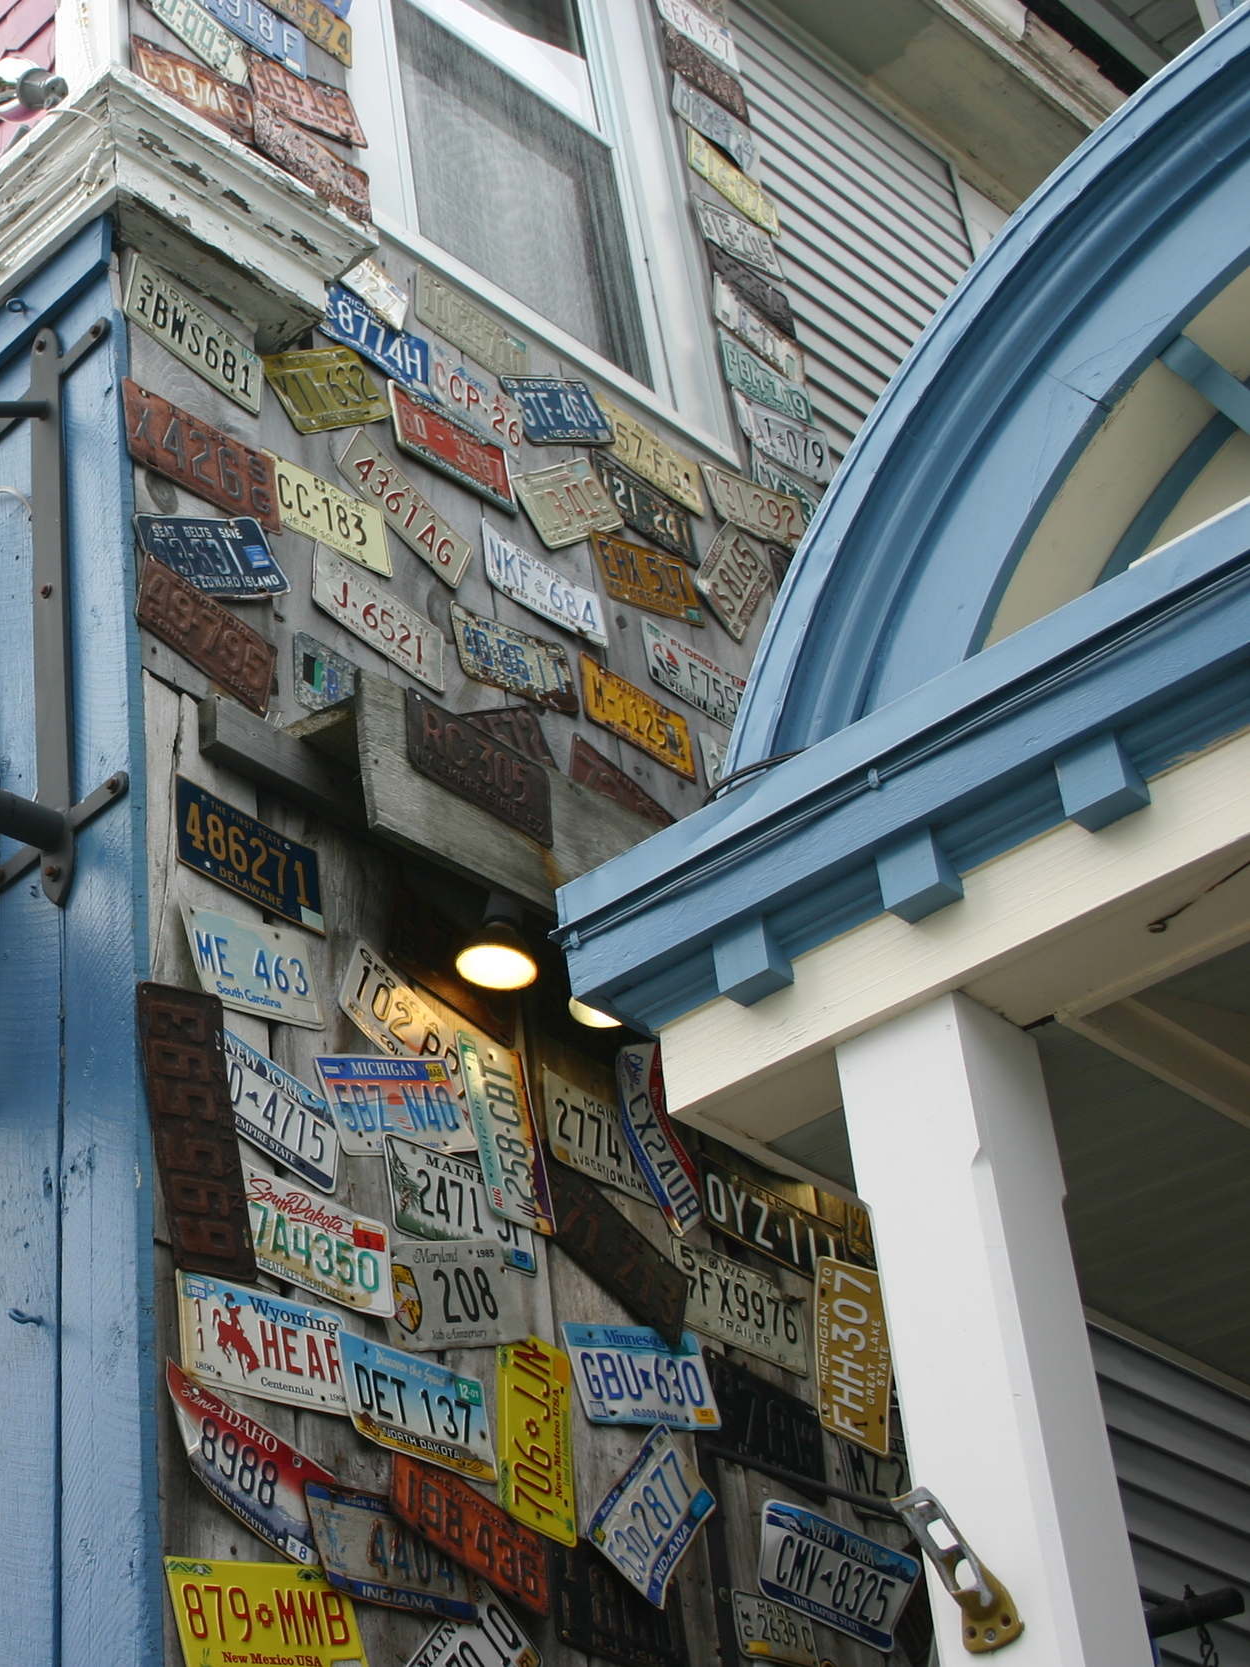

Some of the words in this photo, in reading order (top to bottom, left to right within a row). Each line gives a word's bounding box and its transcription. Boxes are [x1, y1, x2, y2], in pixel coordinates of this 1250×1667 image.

[150, 291, 252, 396] BWS681
[547, 428, 591, 441] NELSON
[277, 472, 369, 547] CC-183
[385, 464, 438, 527] ALASKA
[151, 525, 177, 539] SEAT
[183, 525, 213, 539] BELTS
[217, 526, 244, 540] SAVE
[317, 526, 365, 561] souviens
[200, 574, 241, 590] EDWARD
[241, 573, 280, 589] ISLAND
[550, 581, 598, 630] 684
[669, 638, 722, 676] FLORIDA
[230, 809, 255, 830] FIRST
[257, 823, 283, 849] STATE
[186, 801, 311, 907] 486271
[219, 865, 284, 910] DELAWARE
[216, 981, 247, 1005] South
[245, 988, 283, 1010] Carolina
[252, 949, 310, 998] 463
[359, 947, 441, 1036] GEORGIA
[356, 965, 413, 1046] 102
[223, 1034, 260, 1076] NEW
[258, 1062, 303, 1104] YORK
[350, 1061, 418, 1077] MICHIGAN
[234, 1116, 269, 1147] EMPIRE
[269, 1137, 297, 1164] STATE
[260, 1096, 326, 1163] 4715
[467, 1077, 496, 1169] ARIZONA
[425, 1152, 485, 1186] MAINE
[285, 1191, 348, 1235] Dakota
[491, 1187, 505, 1210] AUG
[247, 1201, 380, 1293] 7A4350
[412, 1248, 459, 1270] Maryland
[475, 1248, 496, 1259] 1985
[248, 1295, 340, 1340] Wyoming
[432, 1266, 499, 1324] 208
[699, 1265, 798, 1345] FX9976
[602, 1329, 667, 1350] Minnesota
[717, 1315, 771, 1347] TRAILER
[819, 1302, 830, 1385] MICHIGAN
[195, 1361, 216, 1374] 1890
[260, 1376, 315, 1397] Centennial
[374, 1350, 409, 1376] Discover
[579, 1351, 644, 1400] GBU
[652, 1355, 706, 1407] 630
[352, 1362, 407, 1424] DET
[418, 1389, 473, 1444] 137
[657, 1409, 679, 1423] lakes
[218, 1403, 278, 1454] IDAHO
[381, 1425, 418, 1446] NORTH
[418, 1438, 461, 1461] DAKOTA
[553, 1420, 563, 1471] Mexico
[200, 1416, 280, 1510] 8988
[513, 1436, 555, 1517] 706
[232, 1503, 277, 1545] POTATOES
[807, 1516, 839, 1545] NEW
[838, 1534, 877, 1564] YORK
[652, 1523, 692, 1585] INDIANA
[361, 1583, 437, 1612] INDIANA
[775, 1532, 824, 1598] CMV
[830, 1559, 897, 1625] 8325
[182, 1582, 251, 1643] 879
[273, 1587, 350, 1646] MMB
[755, 1602, 792, 1620] MAINE
[757, 1614, 798, 1643] 2639
[809, 1601, 837, 1624] EMPIRE
[837, 1614, 861, 1635] STATE
[221, 1651, 249, 1665] New
[249, 1651, 293, 1667] Mexico
[294, 1654, 323, 1667] USA
